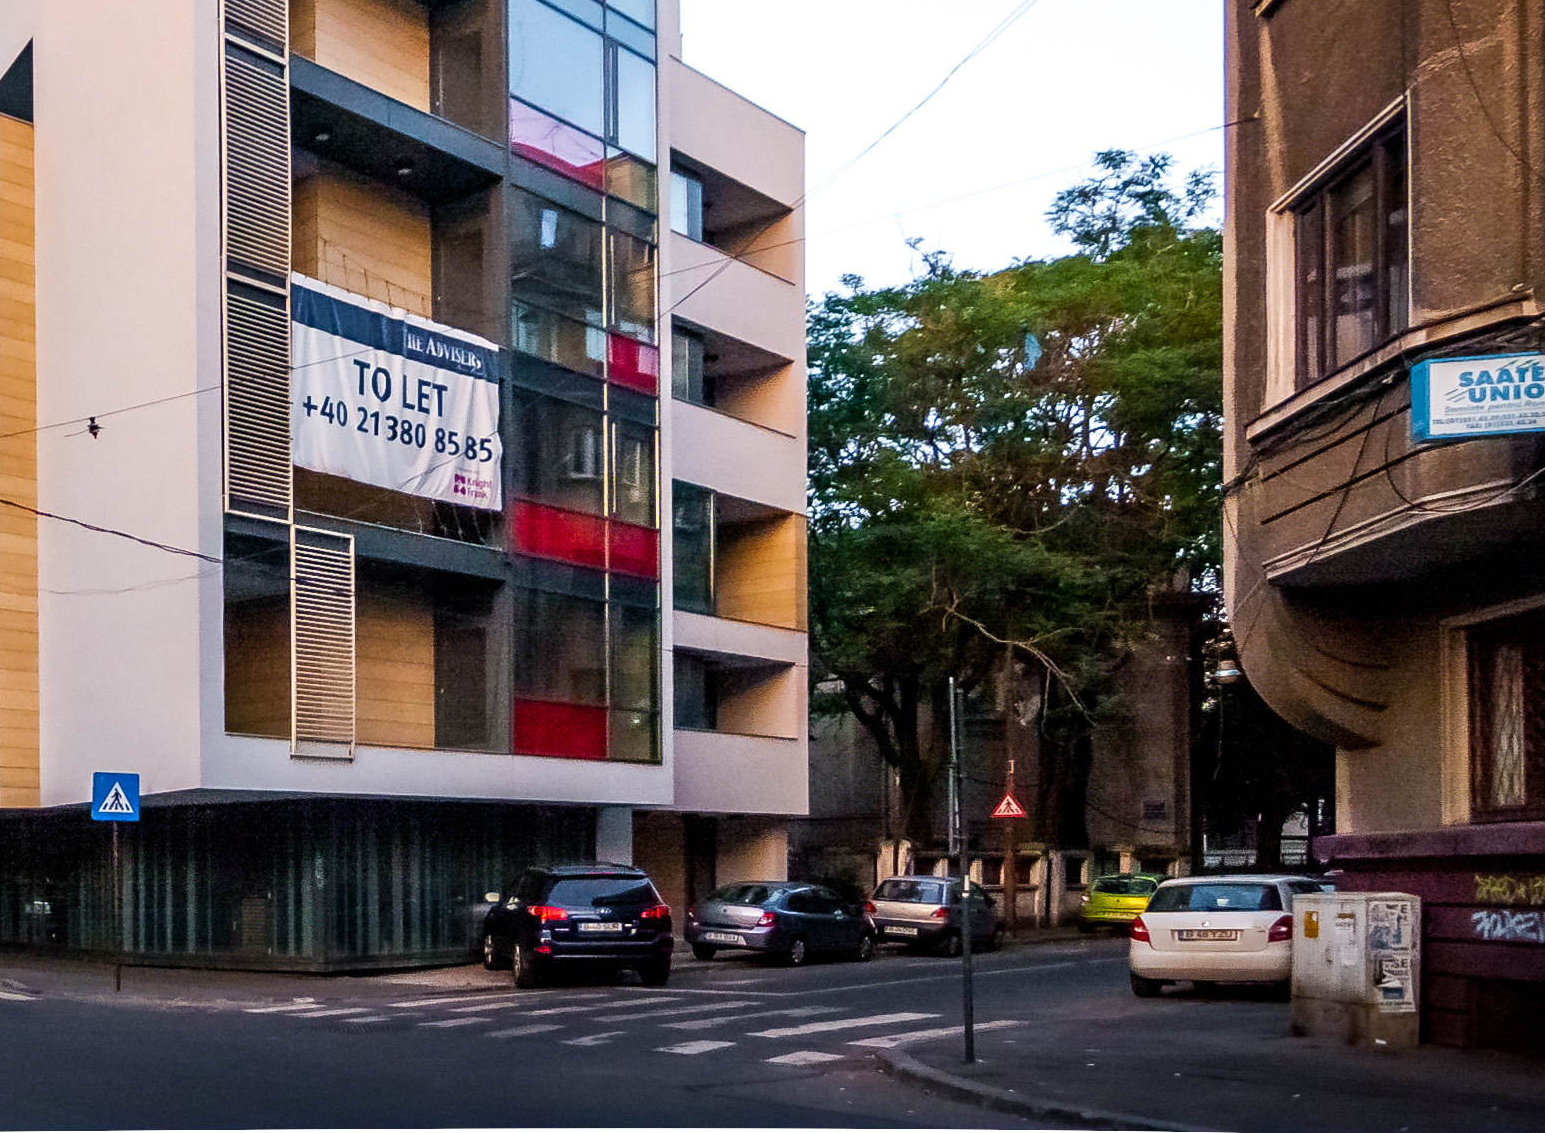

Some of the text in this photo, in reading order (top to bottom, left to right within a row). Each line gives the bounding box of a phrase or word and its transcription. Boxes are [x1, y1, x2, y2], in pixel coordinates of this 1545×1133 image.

[353, 358, 448, 417] TO LET
[303, 395, 348, 427] +40
[467, 477, 492, 489] Knight
